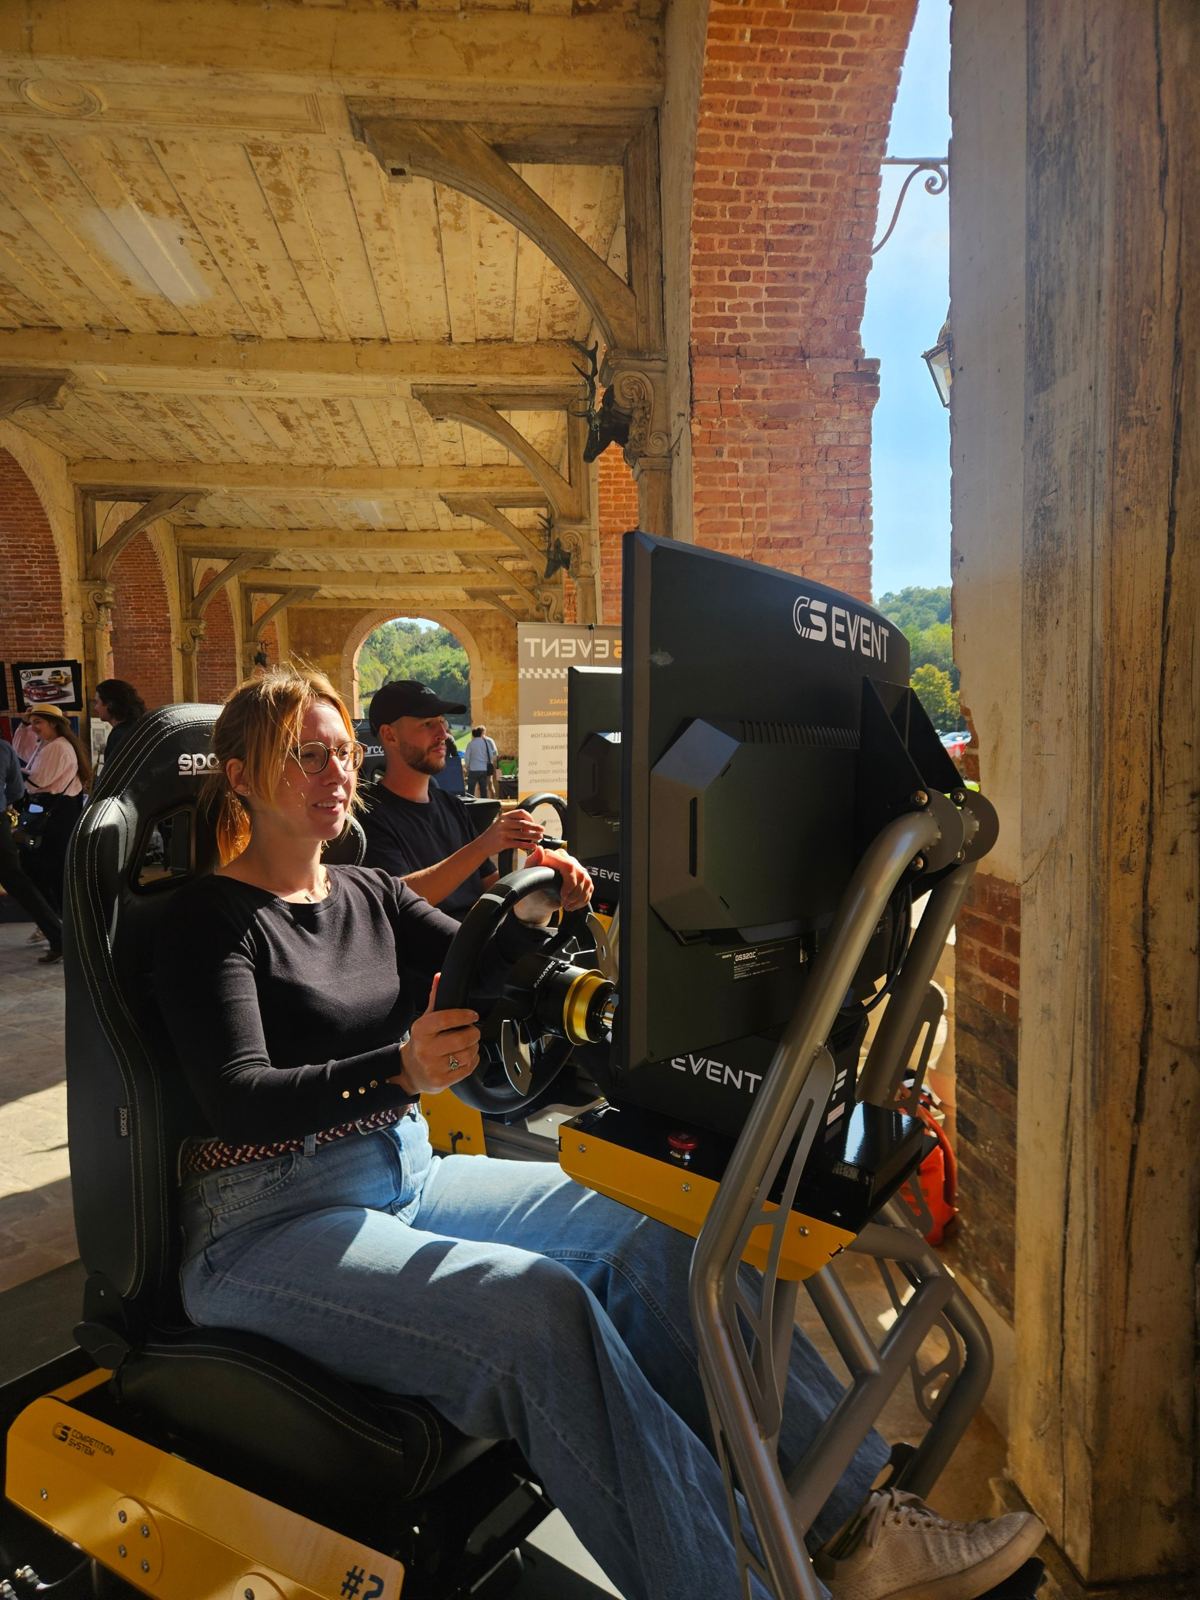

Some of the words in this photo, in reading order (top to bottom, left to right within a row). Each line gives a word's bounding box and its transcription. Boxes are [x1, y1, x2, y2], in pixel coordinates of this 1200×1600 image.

[832, 606, 889, 663] EVENT
[599, 868, 621, 882] EVE
[533, 960, 556, 988] FANATEC
[671, 1053, 762, 1094] EVENT
[67, 1438, 96, 1457] SYSTEM
[71, 1429, 115, 1457] COMPETITION
[340, 1565, 385, 1600] #2
